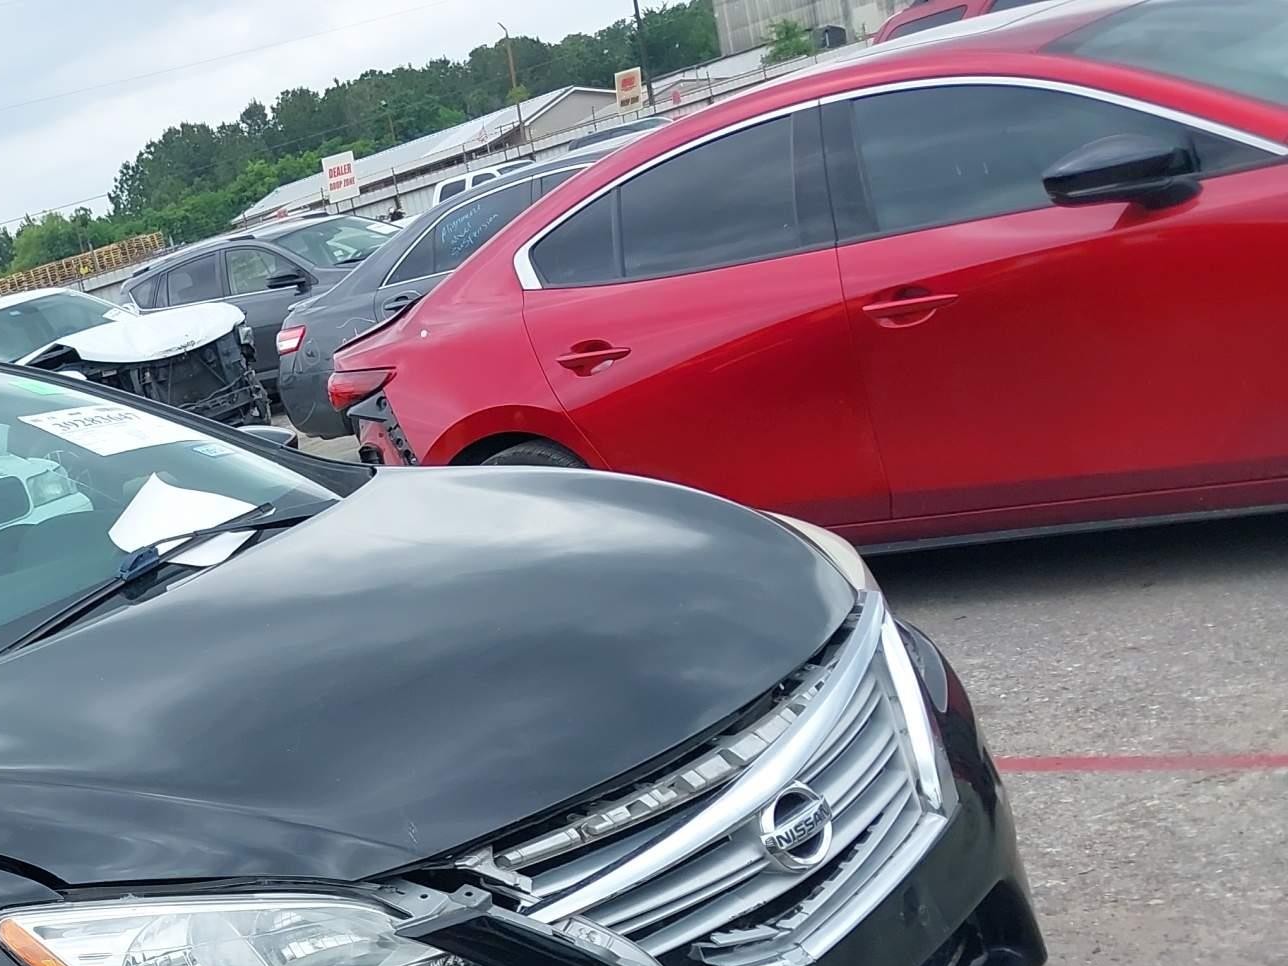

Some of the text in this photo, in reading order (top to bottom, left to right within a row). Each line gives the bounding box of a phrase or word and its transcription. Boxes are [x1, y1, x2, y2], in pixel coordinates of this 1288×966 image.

[328, 163, 352, 179] DEALER
[329, 176, 356, 191] DROP ZONE
[52, 411, 143, 432] 39283647
[777, 805, 830, 847] NISSAN
